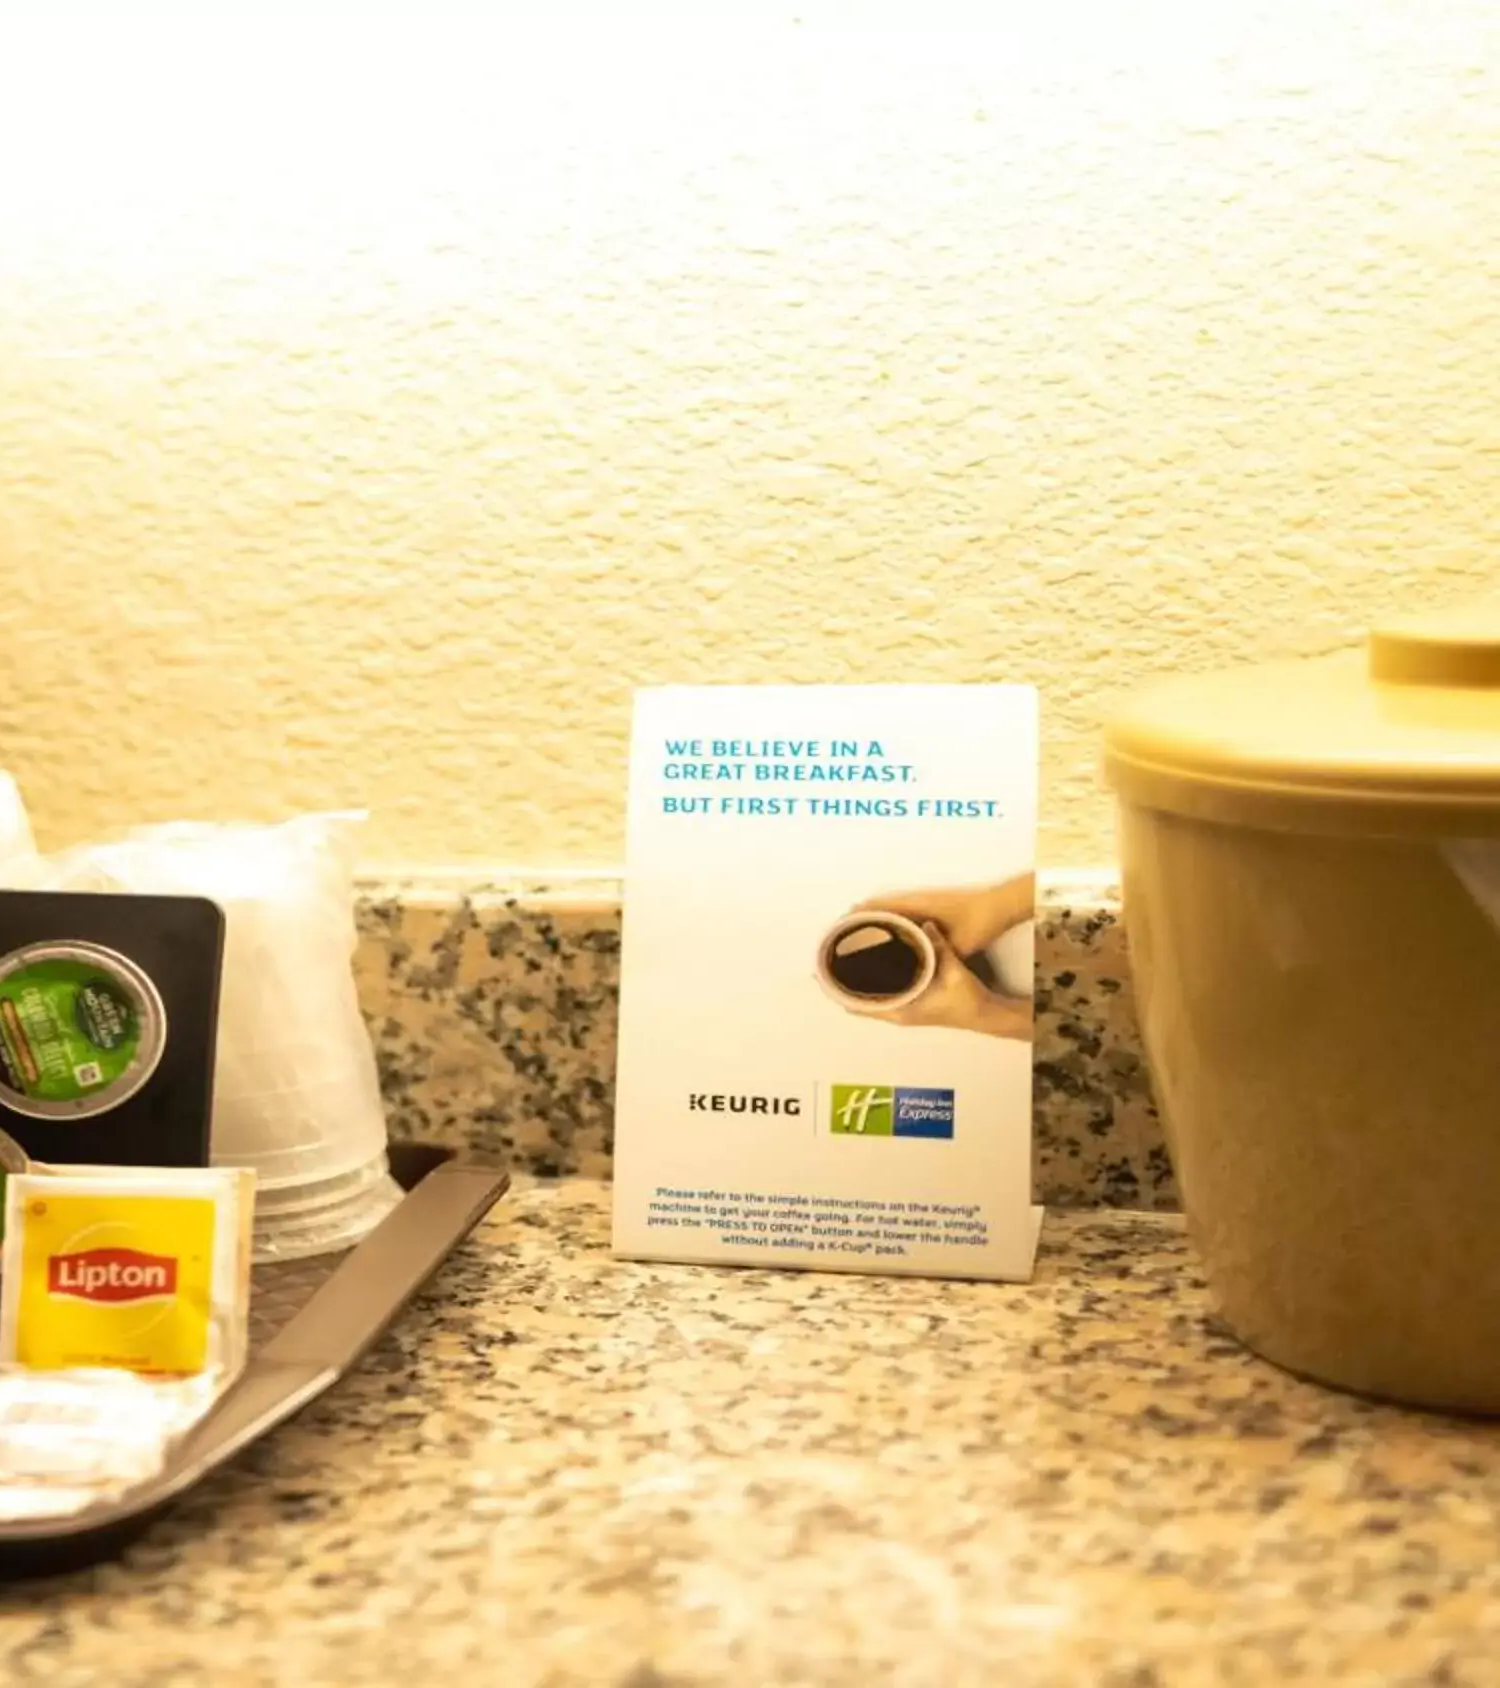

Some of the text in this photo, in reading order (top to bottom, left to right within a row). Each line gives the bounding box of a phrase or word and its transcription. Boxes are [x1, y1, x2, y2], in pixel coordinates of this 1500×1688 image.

[665, 740, 884, 757] WE BELIEVE IN A
[663, 763, 917, 782] GREAT BREAKFAST.
[663, 797, 1003, 819] BUT FIRST THINGS FIRST.
[690, 1094, 801, 1116] KEURIG
[900, 1106, 952, 1121] Express
[656, 1187, 695, 1199] Please
[697, 1190, 726, 1201] refer
[729, 1192, 741, 1201] to
[745, 1193, 765, 1203] the
[768, 1194, 808, 1207] simple
[812, 1197, 886, 1211] instructions
[889, 1201, 905, 1212] on
[908, 1202, 928, 1212] the
[649, 1202, 700, 1213] machine
[704, 1204, 716, 1214] to
[719, 1206, 739, 1218] get
[743, 1208, 770, 1219] your
[773, 1208, 811, 1220] coffee
[856, 1213, 875, 1224] For
[878, 1214, 899, 1225] hot
[944, 1218, 987, 1233] simply
[647, 1216, 678, 1227] press
[682, 1216, 701, 1227] the
[752, 1221, 766, 1232] TO
[811, 1226, 853, 1238] button
[857, 1228, 880, 1239] and
[883, 1229, 917, 1242] lower
[920, 1231, 941, 1243] the
[944, 1233, 989, 1246] handle
[721, 1234, 769, 1247] without
[771, 1238, 815, 1251] adding
[817, 1242, 825, 1250] a
[58, 1259, 166, 1293] Lipton
